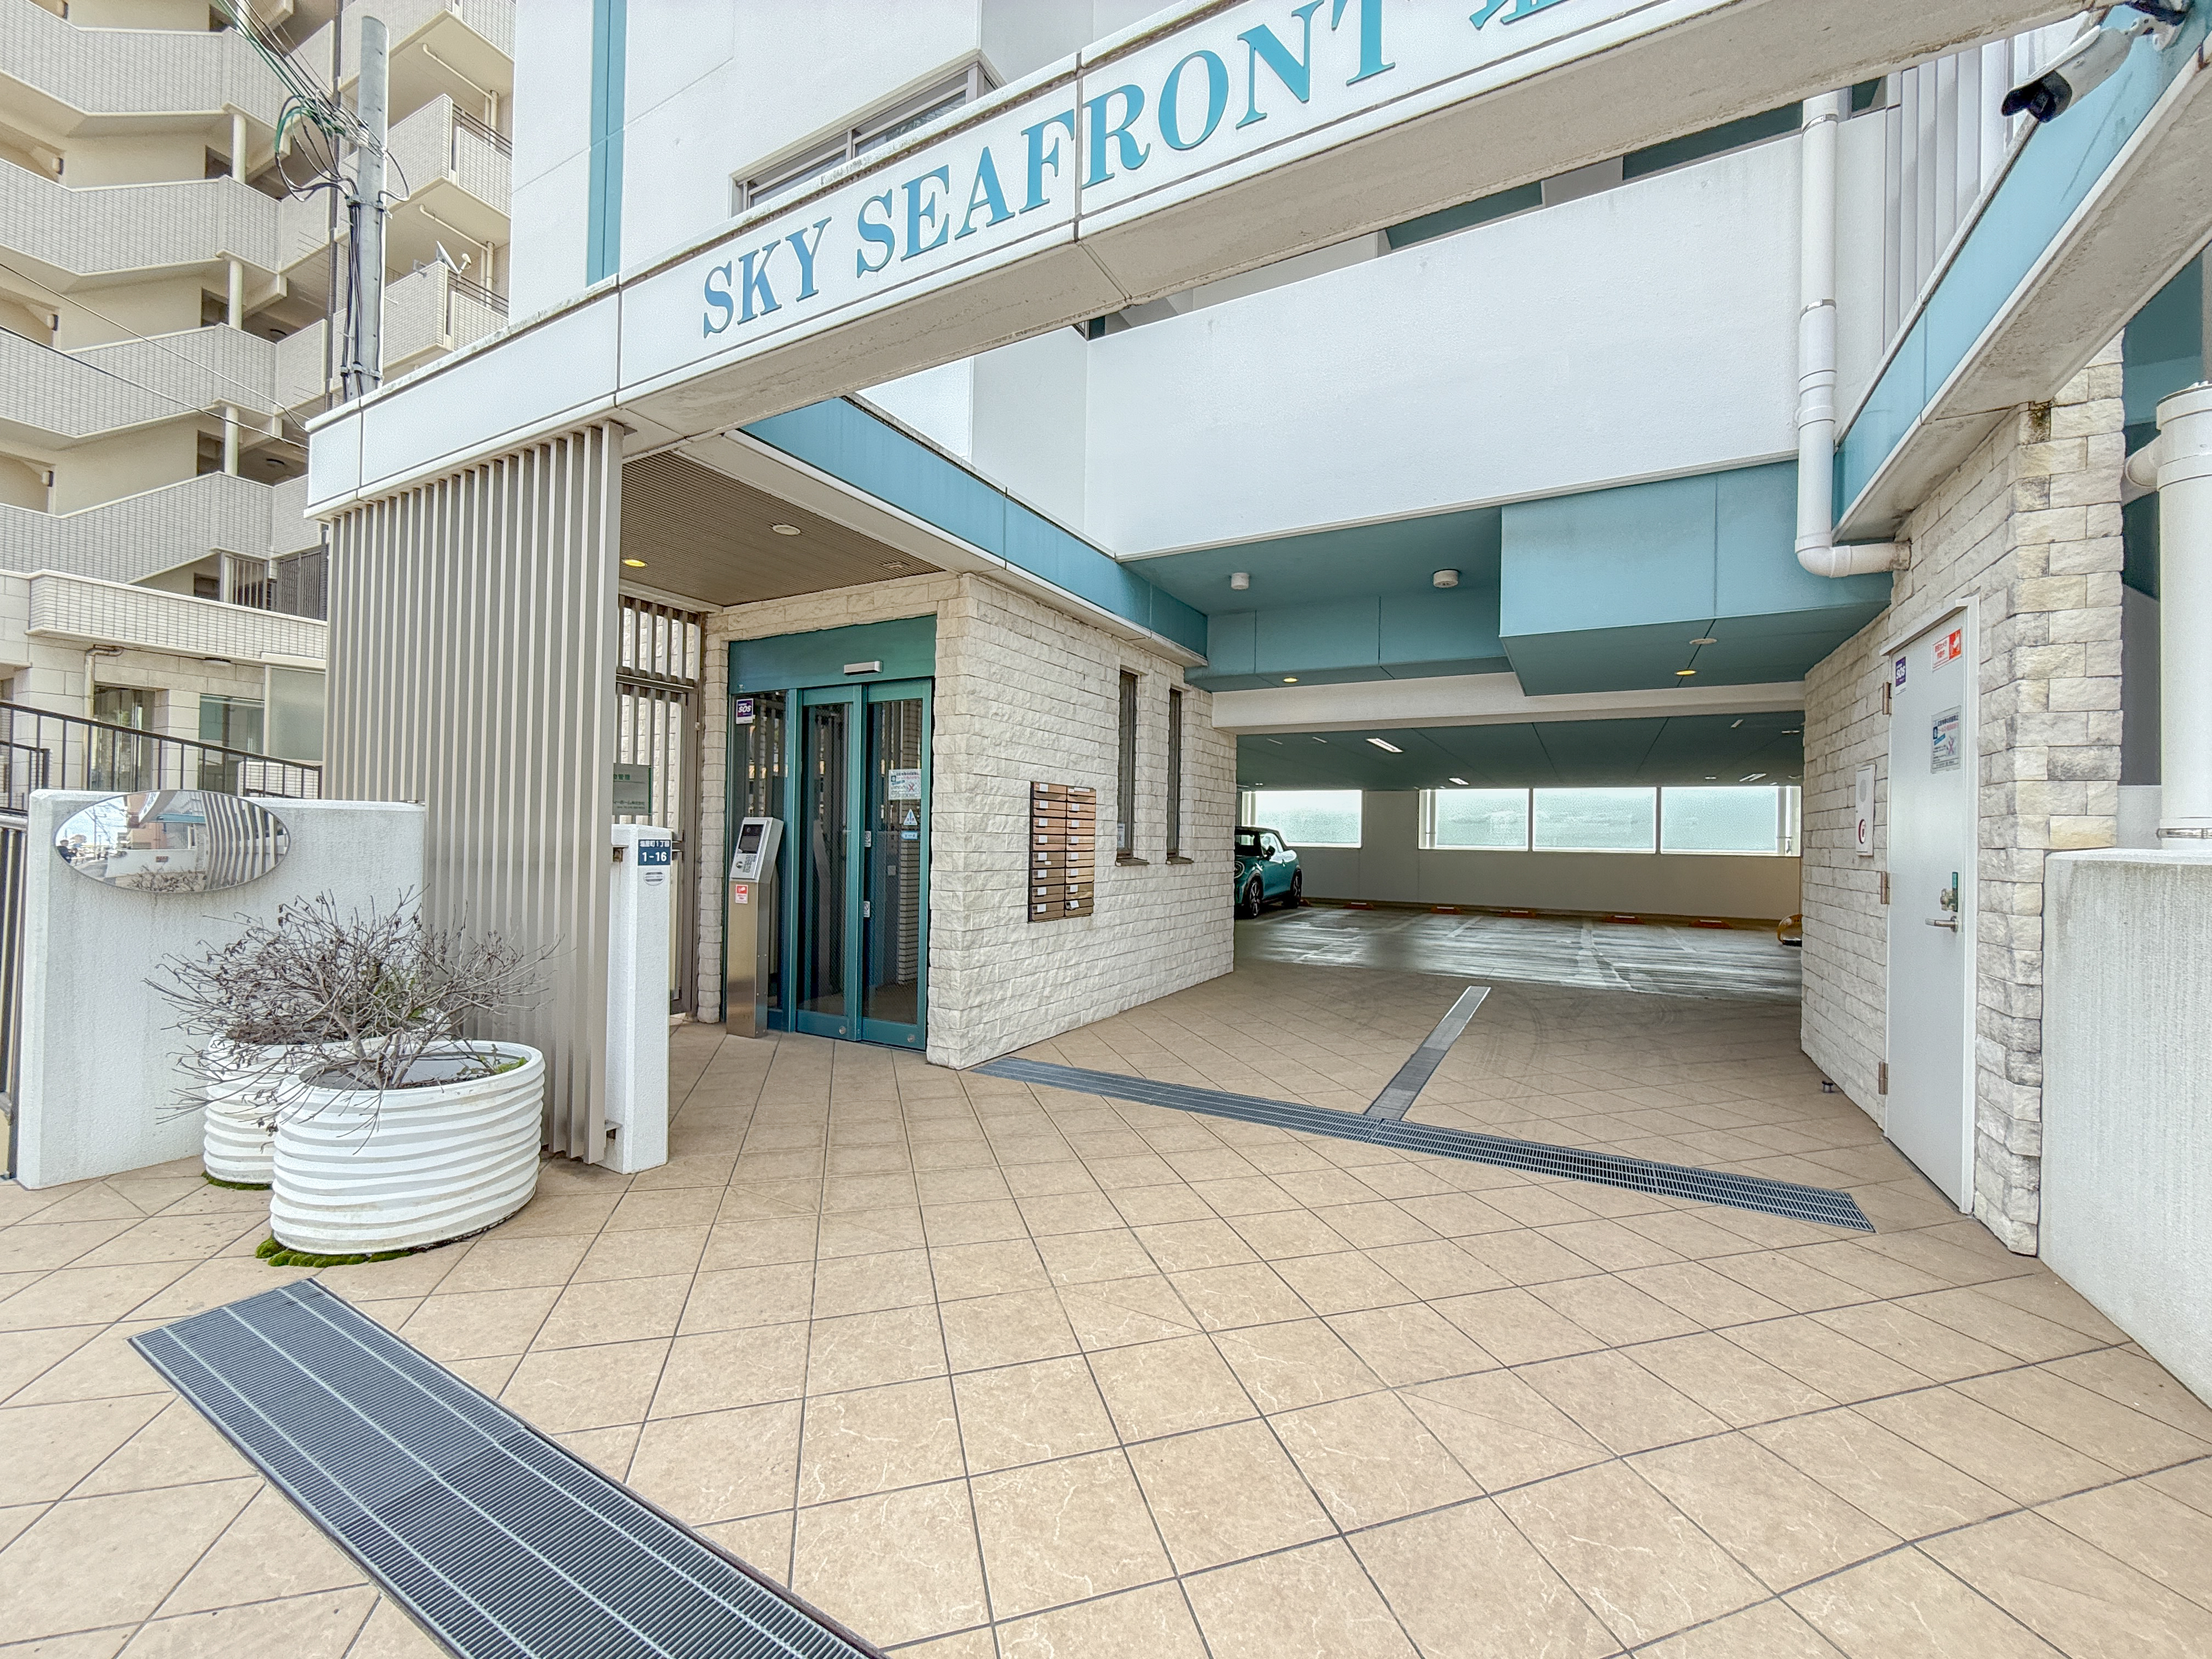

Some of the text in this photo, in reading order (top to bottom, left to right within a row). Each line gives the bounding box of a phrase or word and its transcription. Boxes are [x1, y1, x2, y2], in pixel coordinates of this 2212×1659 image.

[704, 0, 1396, 338] SKY SEAFRONT
[738, 705, 752, 713] SOS
[642, 851, 667, 862] 1-16
